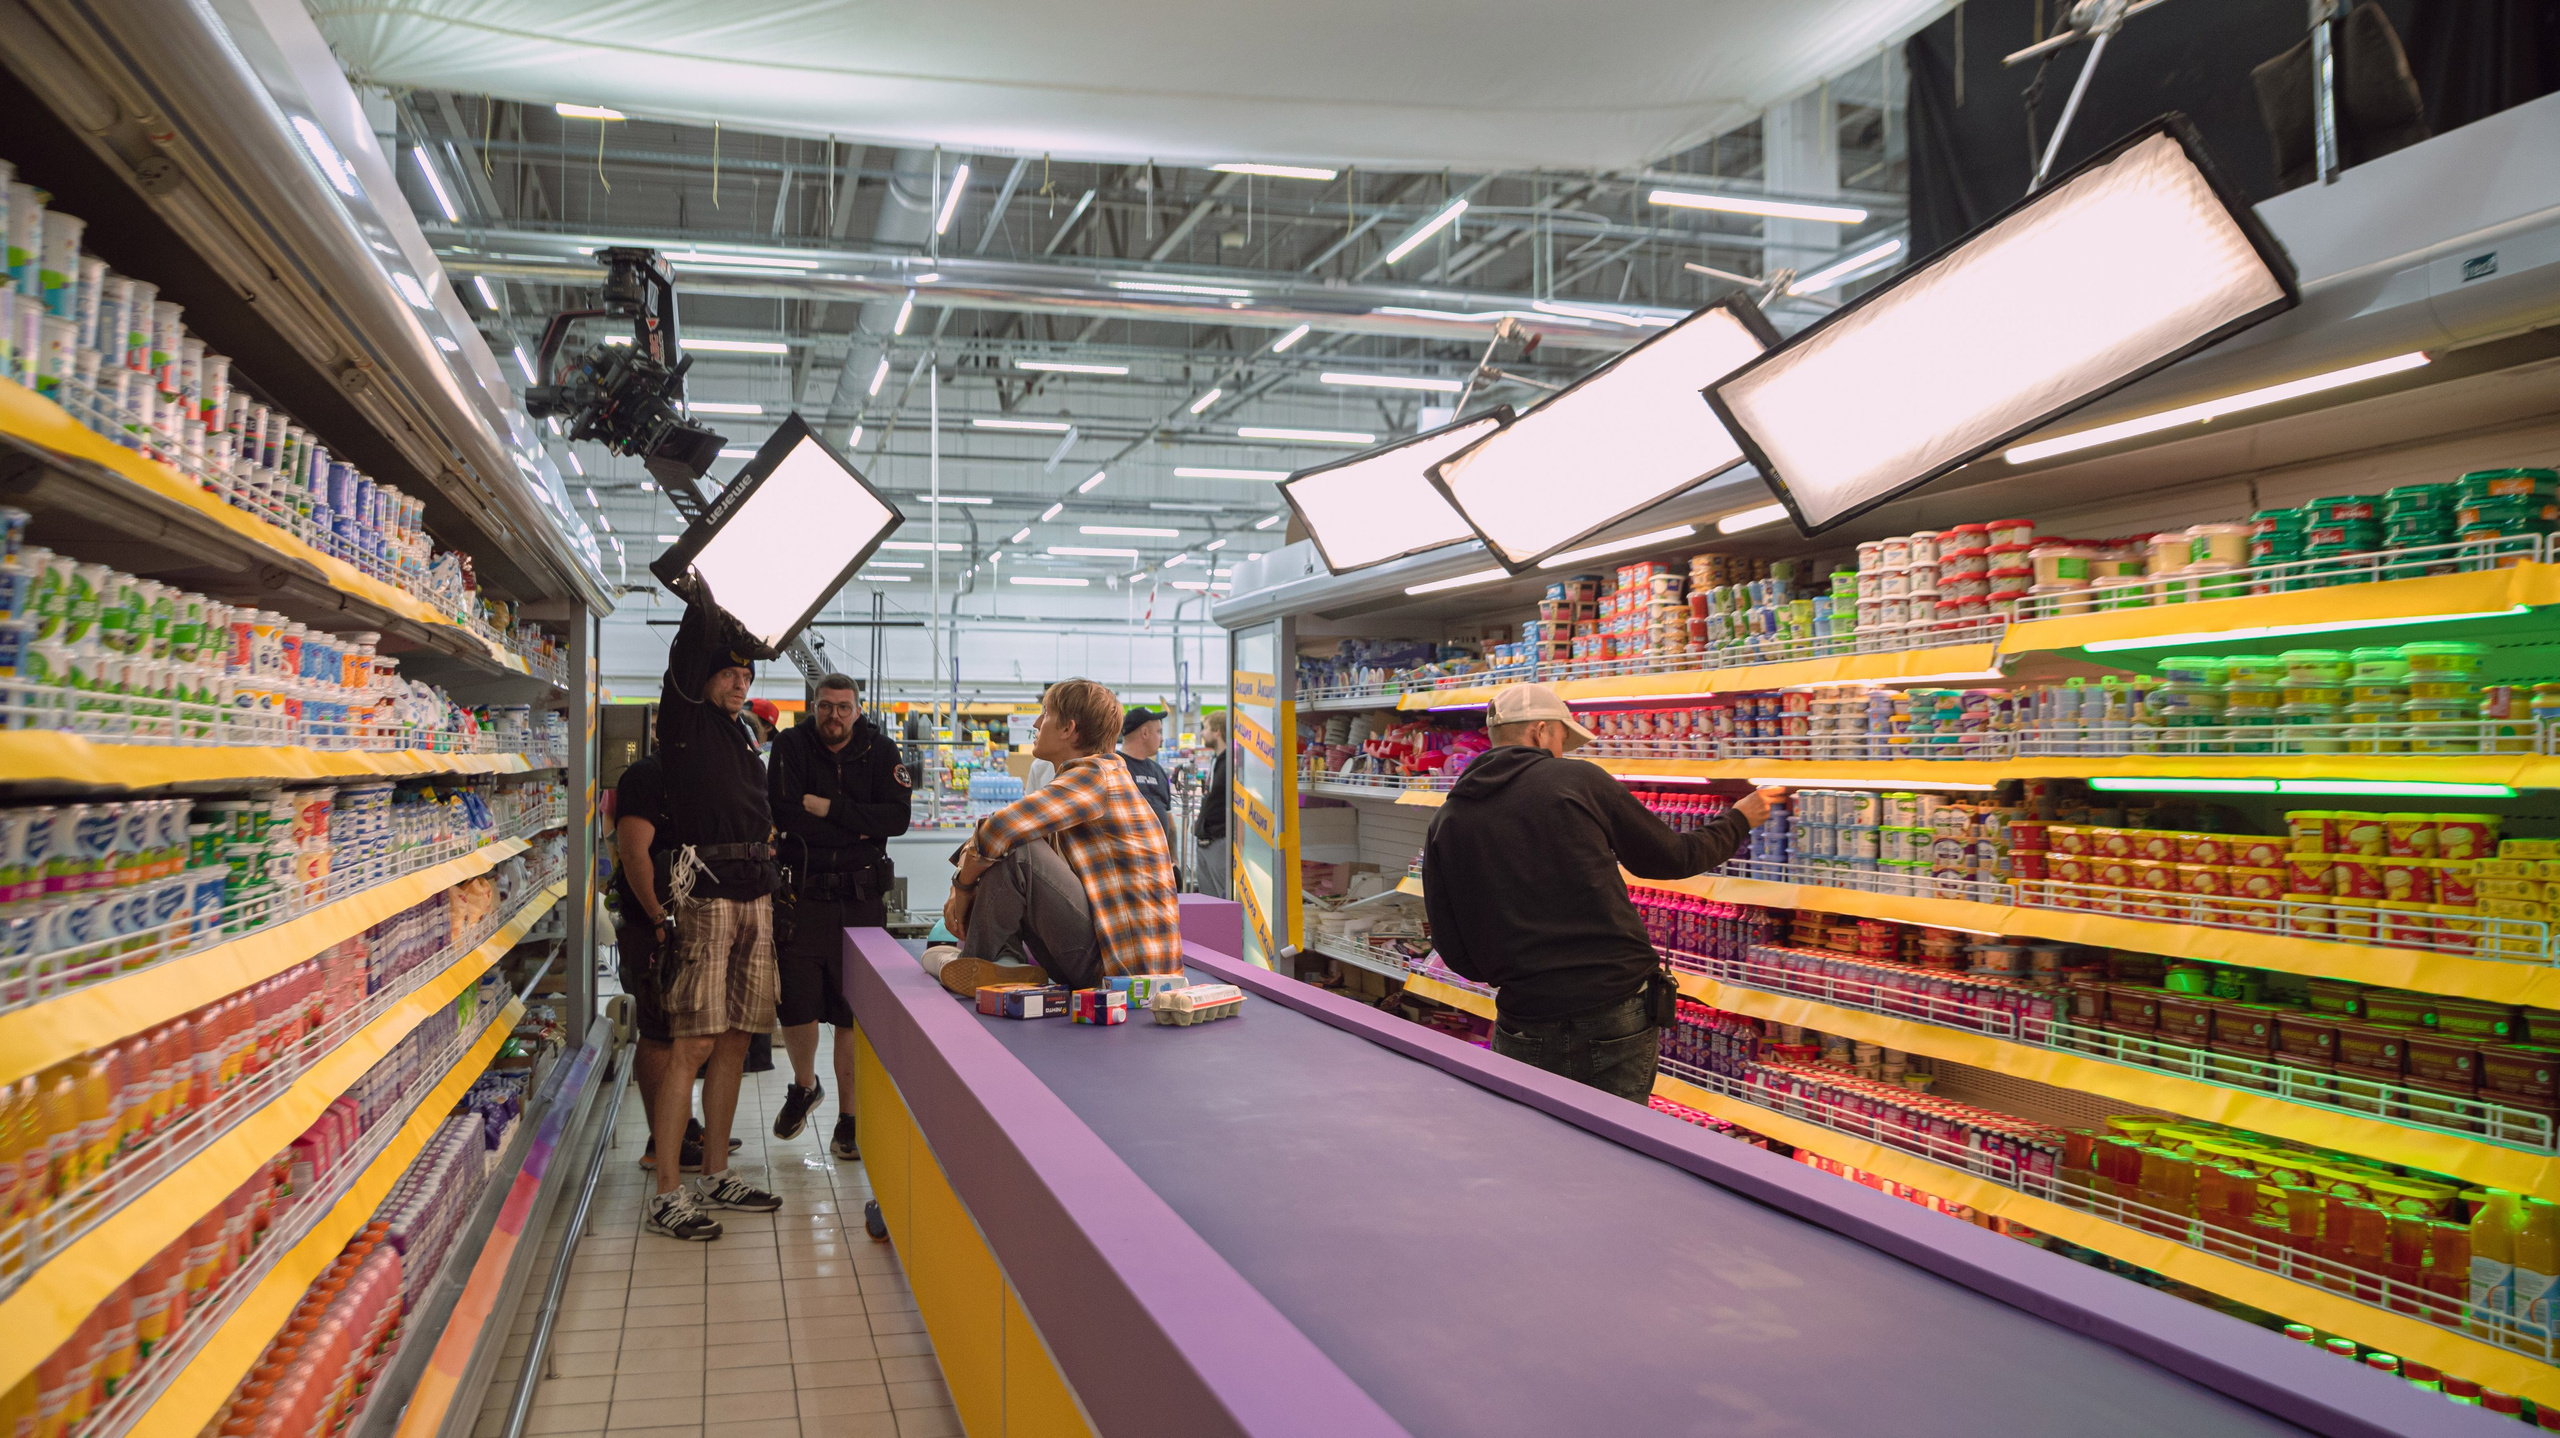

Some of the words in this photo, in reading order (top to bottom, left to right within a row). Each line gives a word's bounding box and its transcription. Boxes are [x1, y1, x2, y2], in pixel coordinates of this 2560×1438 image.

[705, 473, 754, 526] amaran
[1234, 677, 1253, 698] Акция
[1234, 715, 1252, 742] Акция
[1248, 801, 1268, 832] Акция
[1239, 873, 1257, 920] Акция
[1259, 922, 1275, 966] Акци
